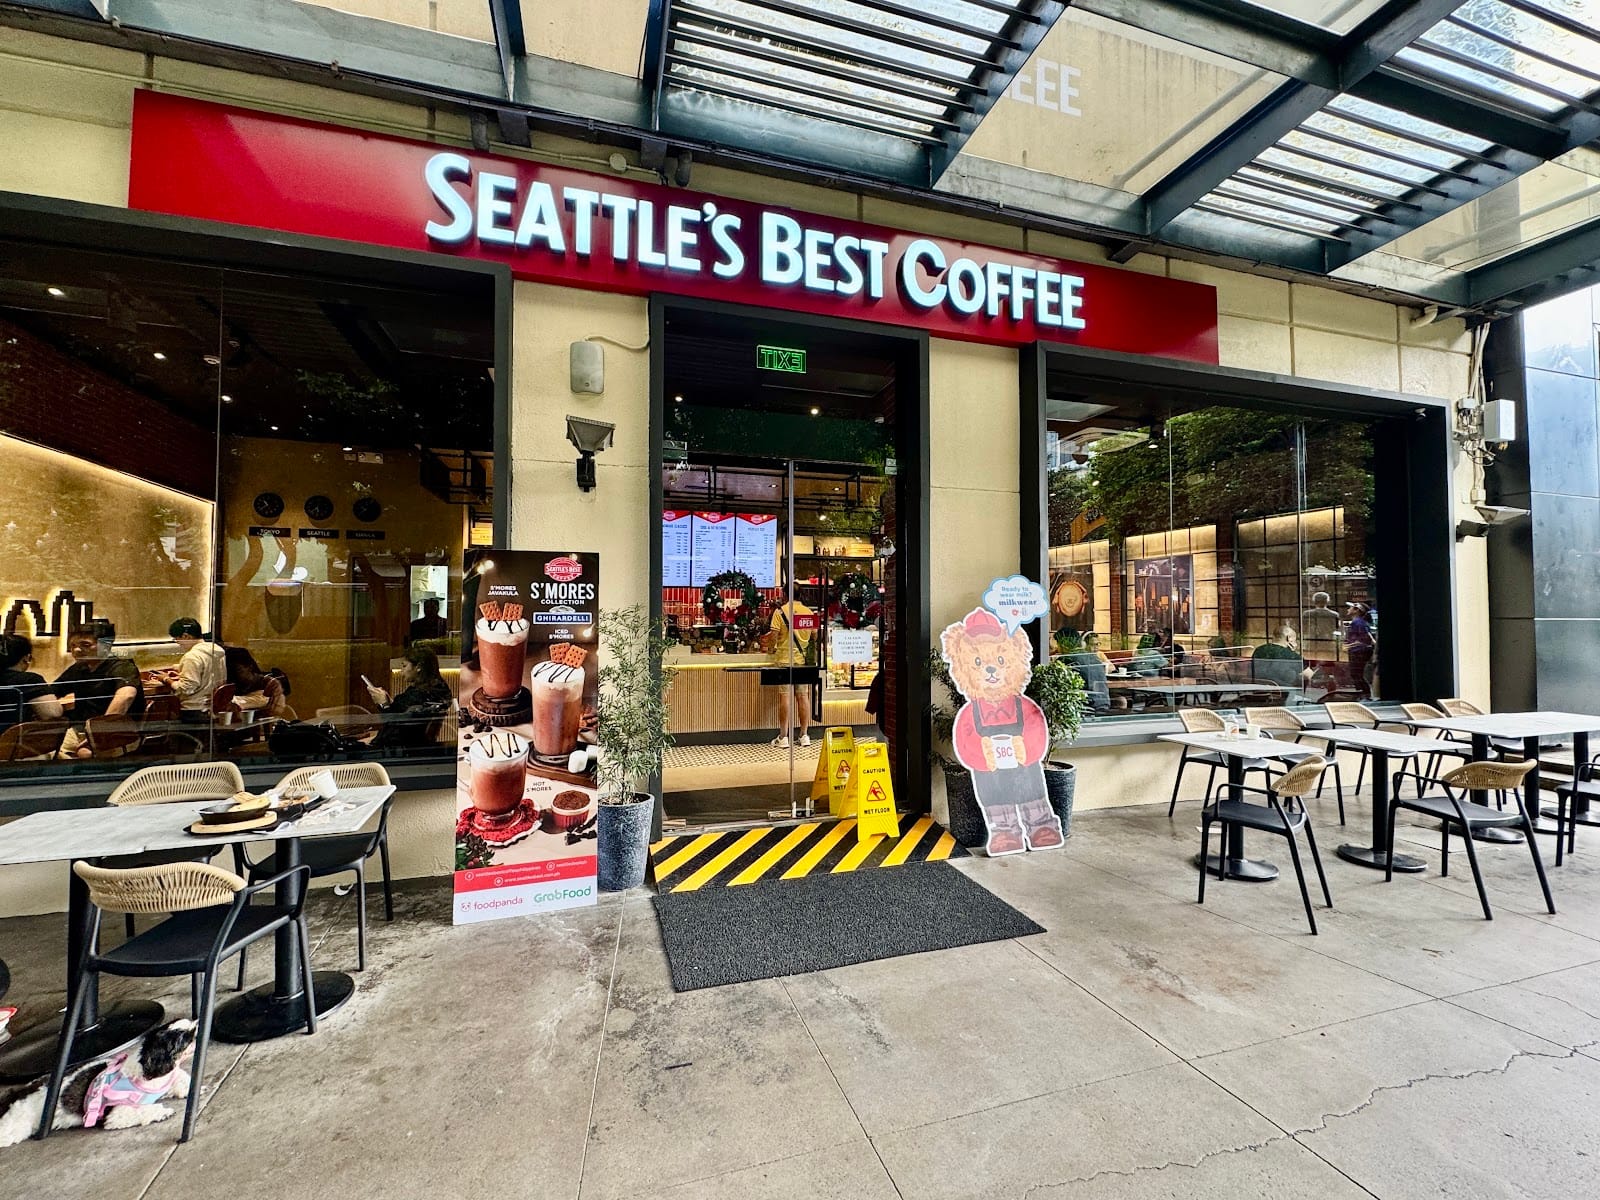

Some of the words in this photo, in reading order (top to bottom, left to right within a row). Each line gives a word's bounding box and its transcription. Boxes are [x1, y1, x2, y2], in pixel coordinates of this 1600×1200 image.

[424, 152, 745, 279] SEATTLE'S
[761, 211, 889, 299] BEST
[899, 239, 1086, 330] COFFEE
[530, 582, 595, 600] S'MORES
[996, 746, 1013, 759] SBC
[473, 896, 524, 910] foodpanda
[533, 886, 592, 903] GrabFood
